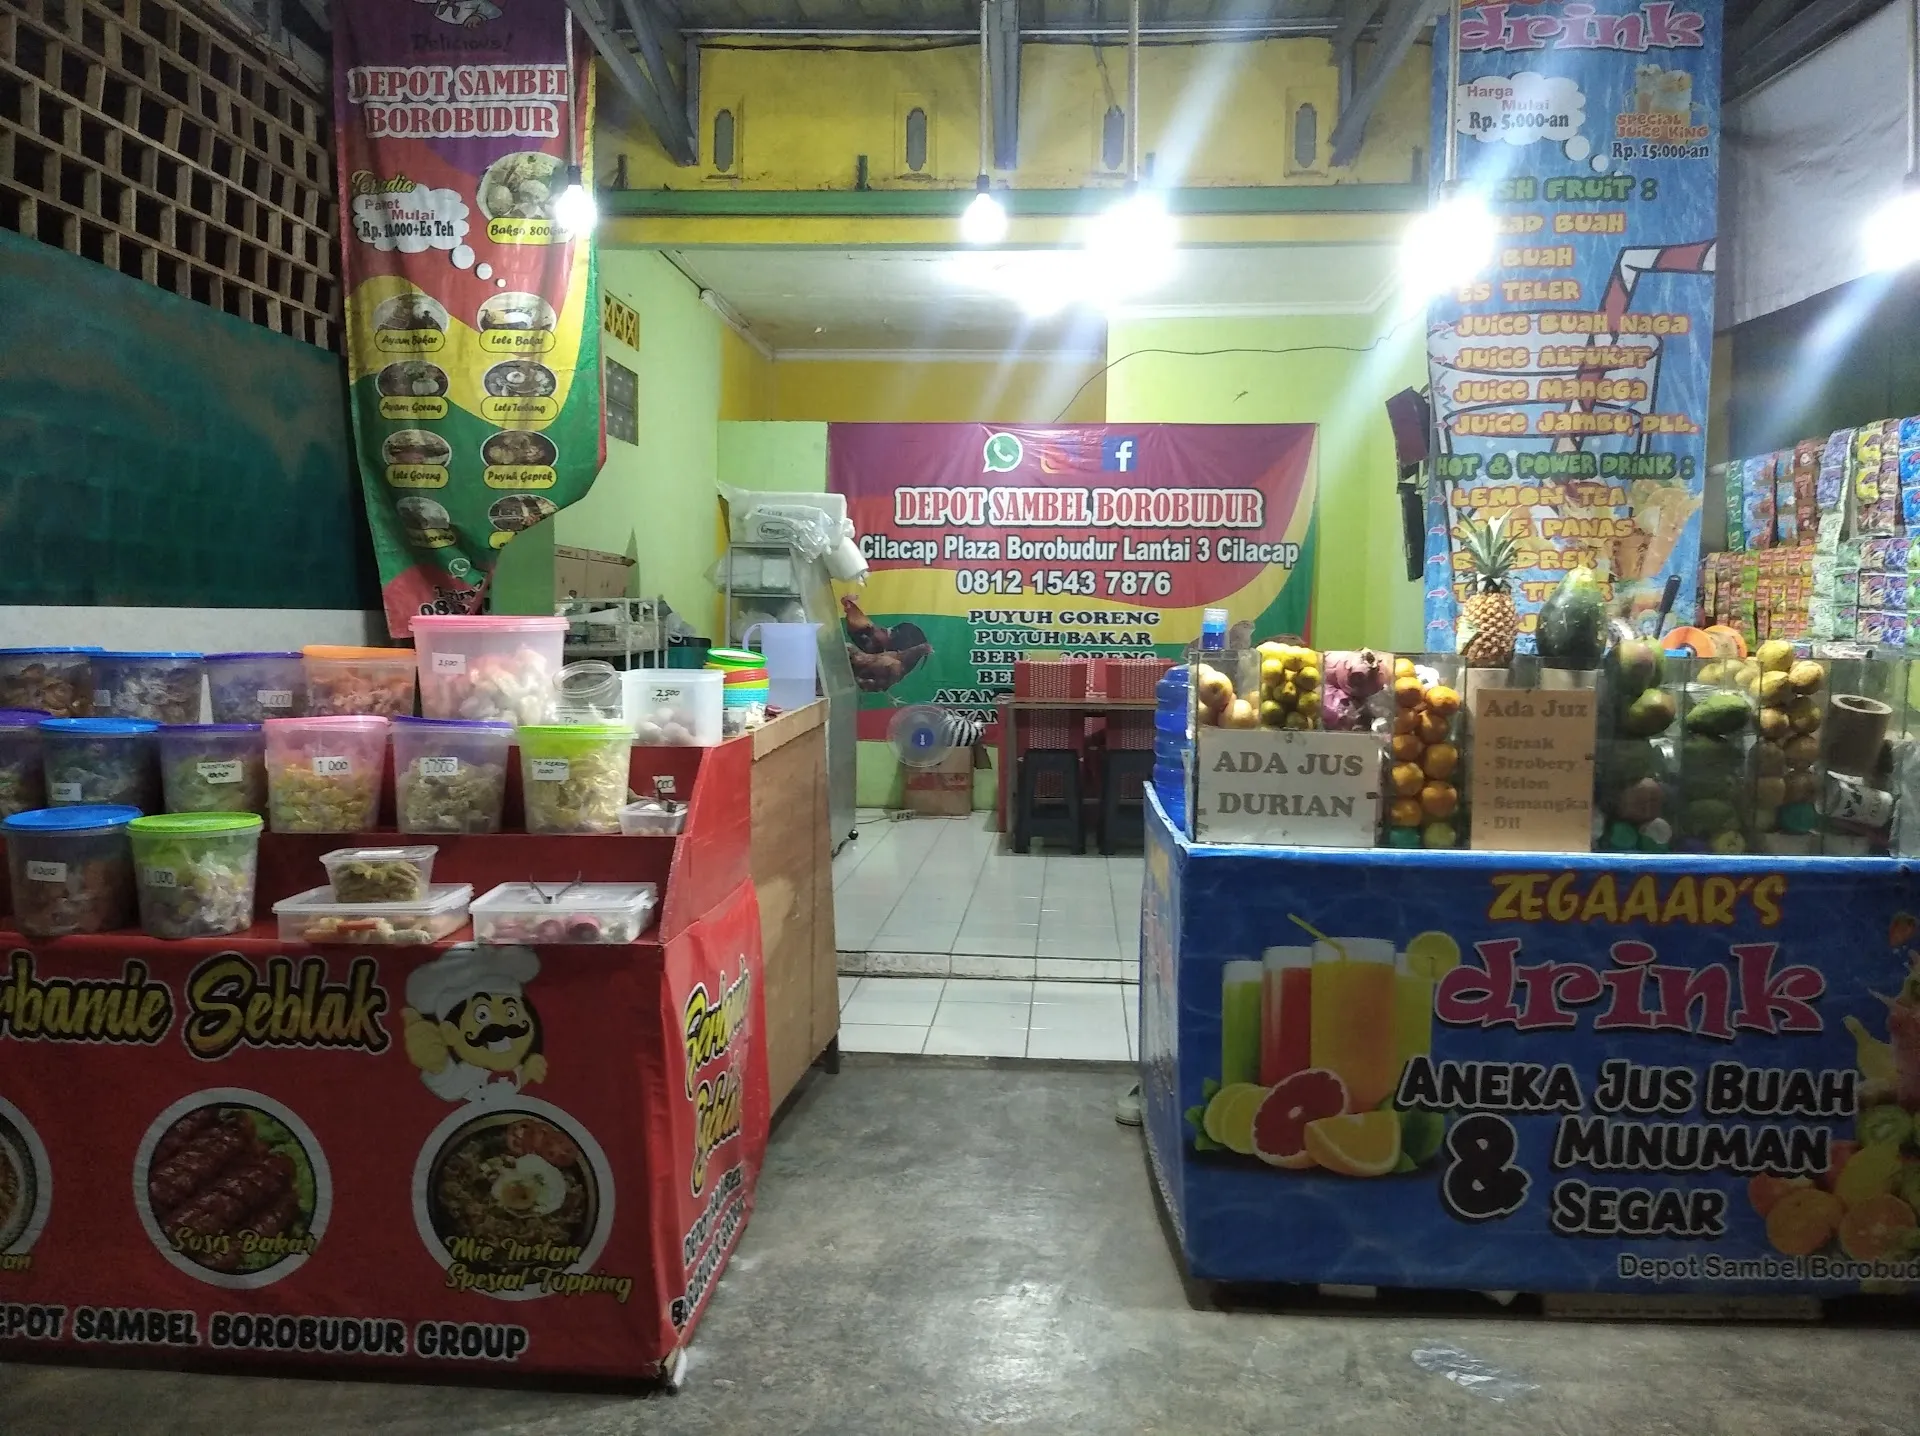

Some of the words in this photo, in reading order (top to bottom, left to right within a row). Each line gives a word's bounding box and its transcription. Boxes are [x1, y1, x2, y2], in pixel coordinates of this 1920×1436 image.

[1459, 2, 1704, 51] drink
[352, 69, 449, 98] DEPOT
[1466, 85, 1514, 101] Harga
[1501, 99, 1550, 111] Mulai
[365, 106, 555, 133] BOROBUDUR
[1469, 112, 1496, 132] Rp.
[1501, 112, 1569, 130] 5.000-an
[1612, 143, 1637, 161] Rp.
[1641, 144, 1709, 160] 15.000-an
[391, 209, 435, 220] Mulai
[435, 221, 454, 236] Teh
[490, 224, 526, 236] Bakso
[1502, 279, 1581, 302] TELER
[382, 335, 410, 346] Ayam
[491, 334, 513, 345] Lele
[515, 334, 544, 346] Bakar
[411, 401, 443, 414] Goreng
[493, 402, 513, 412] Lele
[410, 470, 442, 482] Goreng
[1434, 452, 1482, 477] HOT
[1486, 453, 1512, 479] &
[1516, 451, 1598, 479] POWER
[520, 470, 554, 483] Geprek
[1451, 485, 1566, 507] LEMON
[1578, 485, 1628, 507] TEA
[898, 491, 985, 523] DEPOT
[992, 491, 1089, 524] SAMBEL
[1096, 491, 1261, 526] BOROBUDUR
[1541, 517, 1636, 539] PANAS
[860, 536, 937, 565] Cilacap
[943, 535, 1000, 560] Plaza
[1006, 536, 1118, 562] Borobudur
[1124, 536, 1191, 563] Lantai
[1197, 538, 1212, 563] 3
[1216, 539, 1300, 569] Cilacap
[957, 571, 1023, 595] 0812
[1030, 571, 1097, 595] 1543
[1104, 571, 1172, 596] 7876
[968, 609, 1055, 626] PUYUH
[1058, 610, 1161, 626] GORENG
[975, 630, 1063, 646] PUYUH
[1064, 631, 1153, 647] BAKAR
[656, 689, 681, 697] 2500
[1484, 699, 1536, 718] Ada
[1541, 699, 1588, 718] Juz
[1494, 736, 1556, 750] Sirsak
[1213, 750, 1290, 775] ADA
[1298, 752, 1364, 776] JUS
[1494, 756, 1578, 773] Strobery
[1494, 776, 1551, 791] Melon
[1217, 792, 1356, 818] DURIAN
[1489, 873, 1788, 925] ZEGAAAR'S
[1434, 938, 1826, 1040] drink
[183, 951, 392, 1062] Seblak
[1397, 1056, 1585, 1112] ANEKA
[1592, 1058, 1697, 1115] JUS
[1705, 1061, 1860, 1116] BUAH
[1553, 1115, 1833, 1174] MINUMAN
[1444, 1112, 1532, 1220] &
[1552, 1180, 1727, 1236] SEGAR
[172, 1226, 230, 1255] Sosis
[238, 1228, 318, 1256] Bakar
[445, 1236, 492, 1262] Mie
[500, 1236, 582, 1262] Instan
[1620, 1256, 1698, 1282] Depot
[1705, 1255, 1803, 1280] Sambel
[445, 1263, 528, 1295] Spesial
[532, 1267, 633, 1303] Topping
[73, 1305, 199, 1346] SAMBEL
[209, 1312, 409, 1356] BOROBUDUR
[414, 1321, 529, 1362] GROUP
